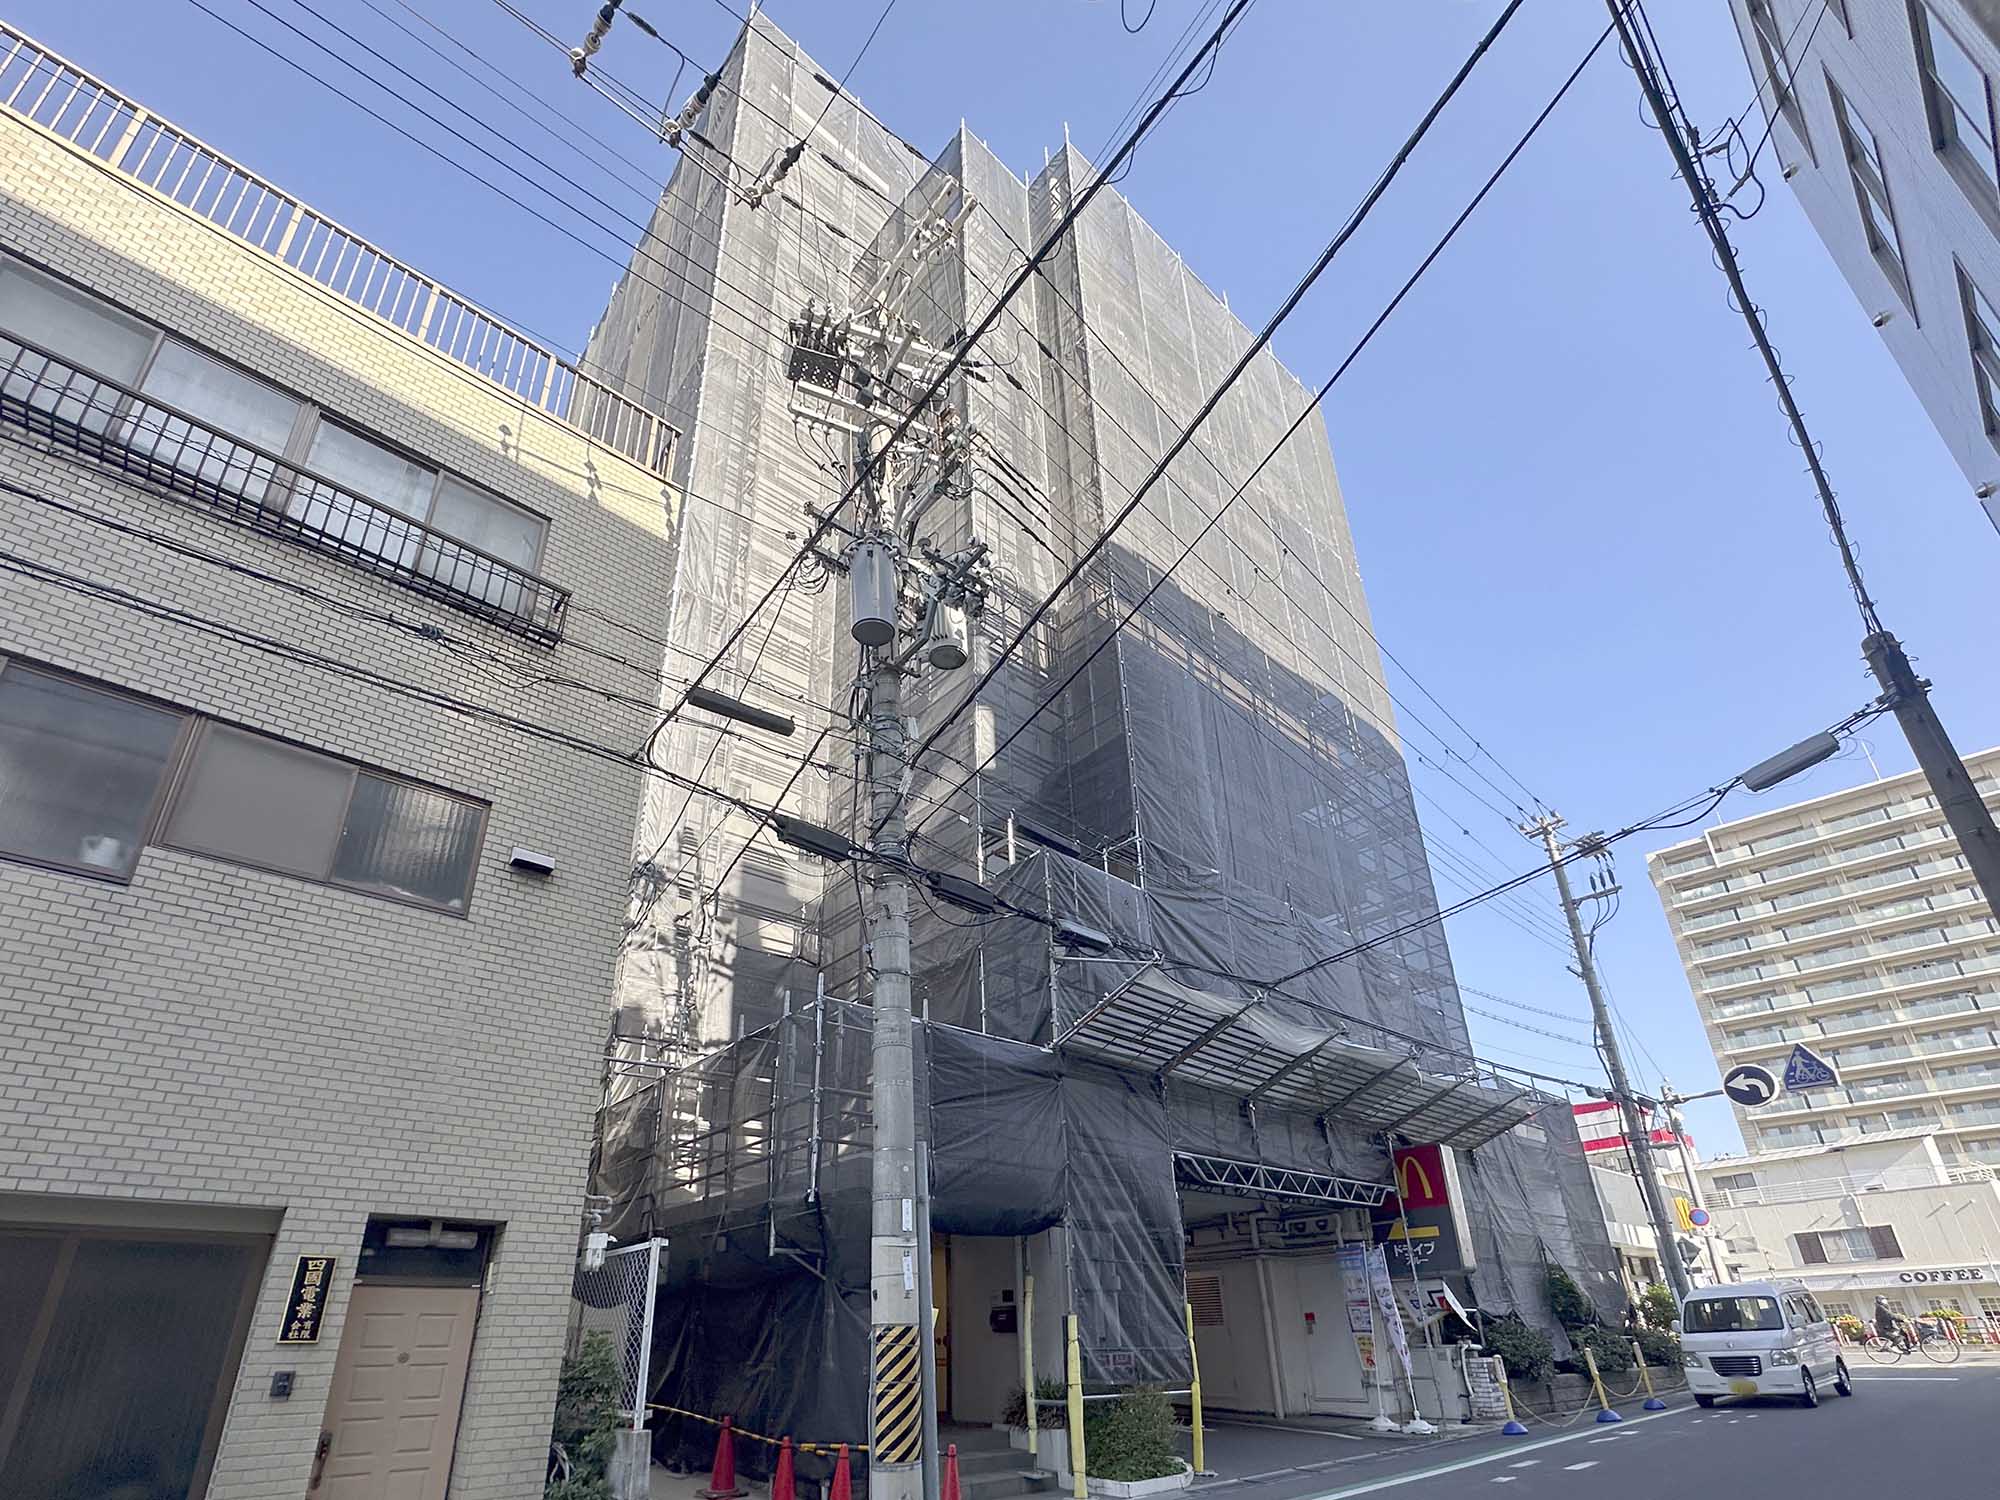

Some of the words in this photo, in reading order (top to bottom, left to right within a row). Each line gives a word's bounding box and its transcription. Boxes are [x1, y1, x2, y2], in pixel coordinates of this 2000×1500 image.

[296, 1259, 327, 1319] 四國電業
[1899, 1268, 1984, 1283] COFFEE
